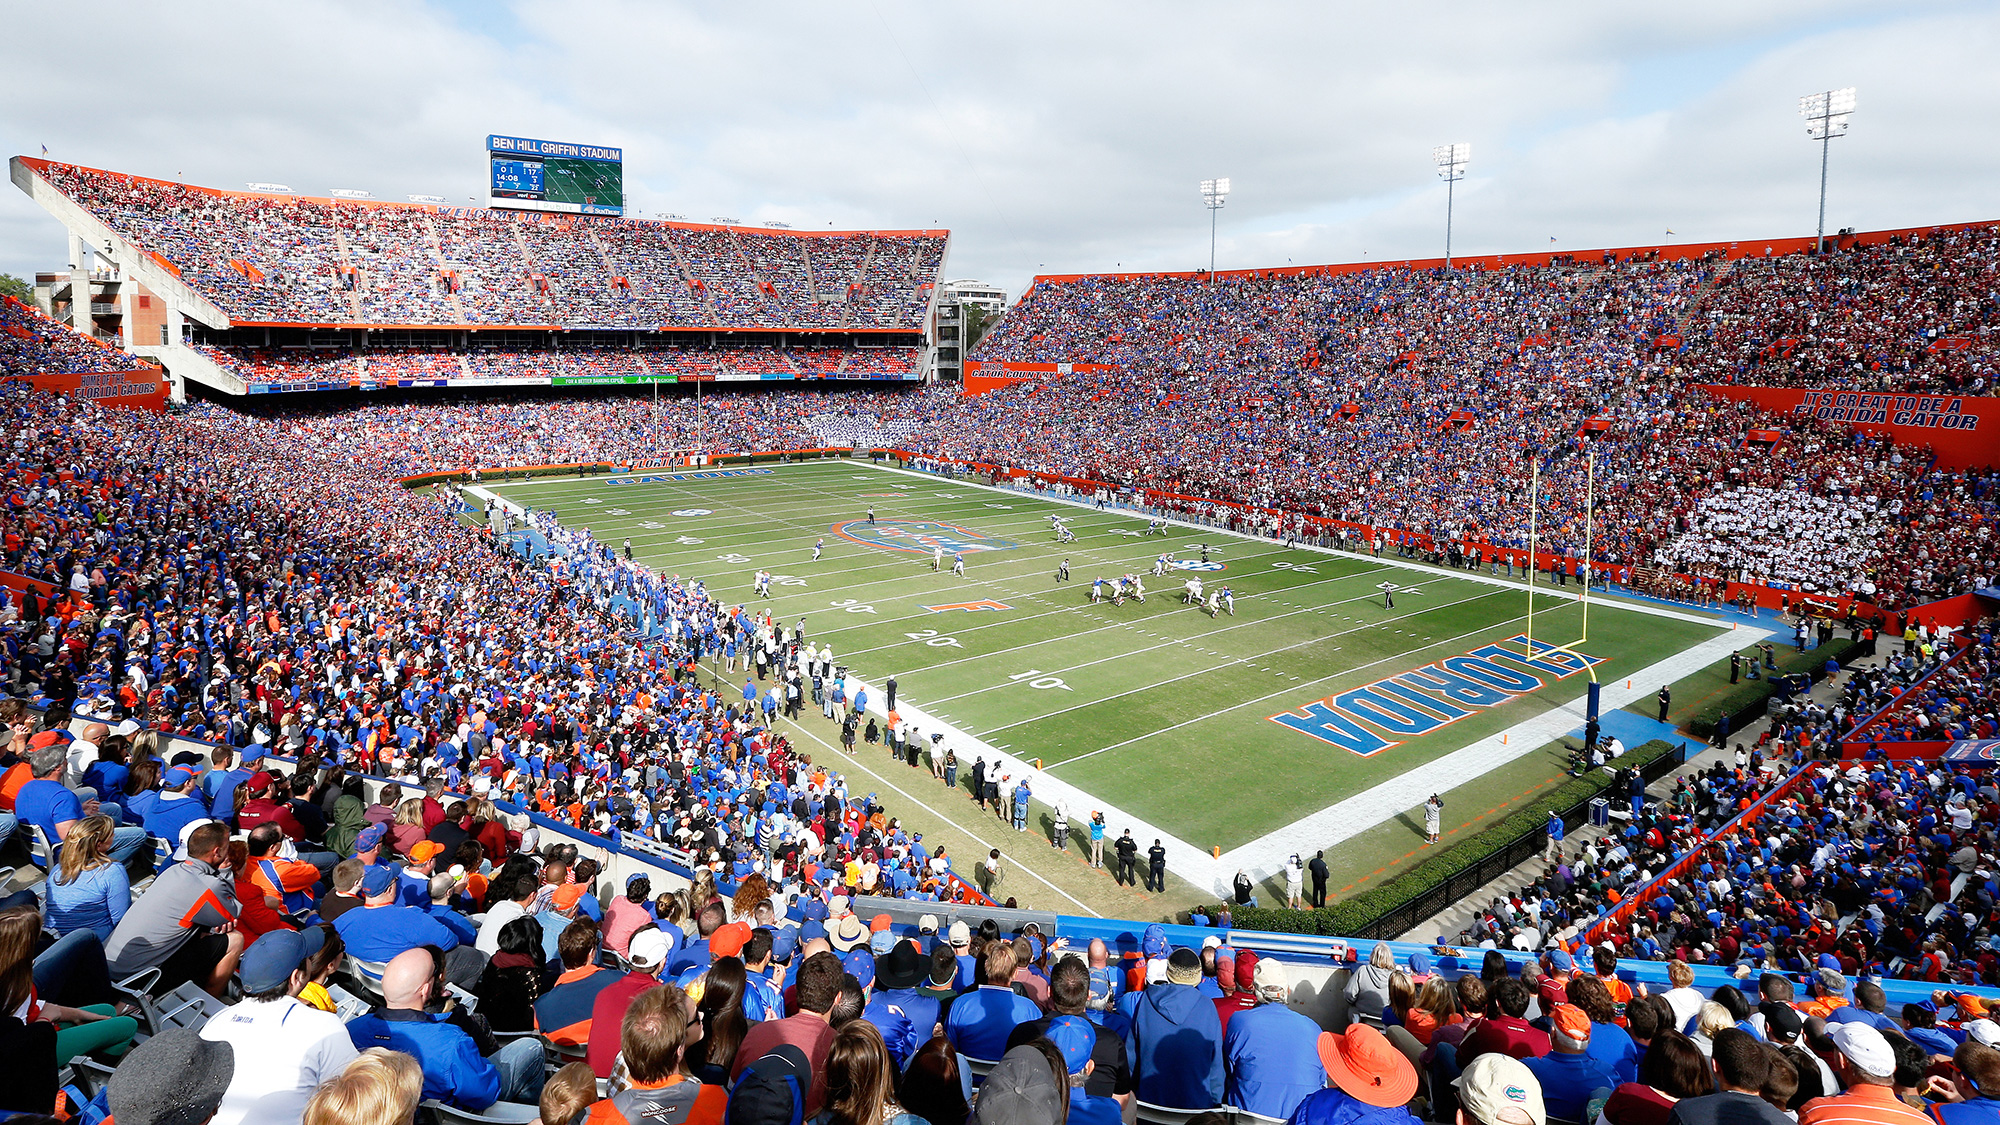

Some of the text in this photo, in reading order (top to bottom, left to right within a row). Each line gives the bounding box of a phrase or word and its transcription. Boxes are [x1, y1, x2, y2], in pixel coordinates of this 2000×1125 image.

[493, 137, 620, 160] BEN HILL GRIFFIN STADIUM
[497, 174, 518, 182] 14:08
[437, 206, 521, 220] WELCOME
[523, 211, 543, 221] TO
[544, 202, 574, 211] Publix
[971, 370, 1005, 378] GATOR
[980, 363, 996, 371] THIS
[81, 374, 102, 387] HOME
[102, 373, 111, 386] OF
[74, 381, 156, 400] FLORIDA GATORS
[1803, 391, 1963, 414] IT'S GREAT TO BE A
[1794, 404, 1980, 430] FLORIDA GATOR
[605, 468, 775, 485] GATORS
[717, 553, 752, 563] 50
[830, 599, 876, 614] 30
[904, 629, 960, 647] 20
[1008, 669, 1070, 690] 10
[1265, 633, 1612, 758] FLORIDA
[641, 1106, 677, 1117] MONGOOSE
